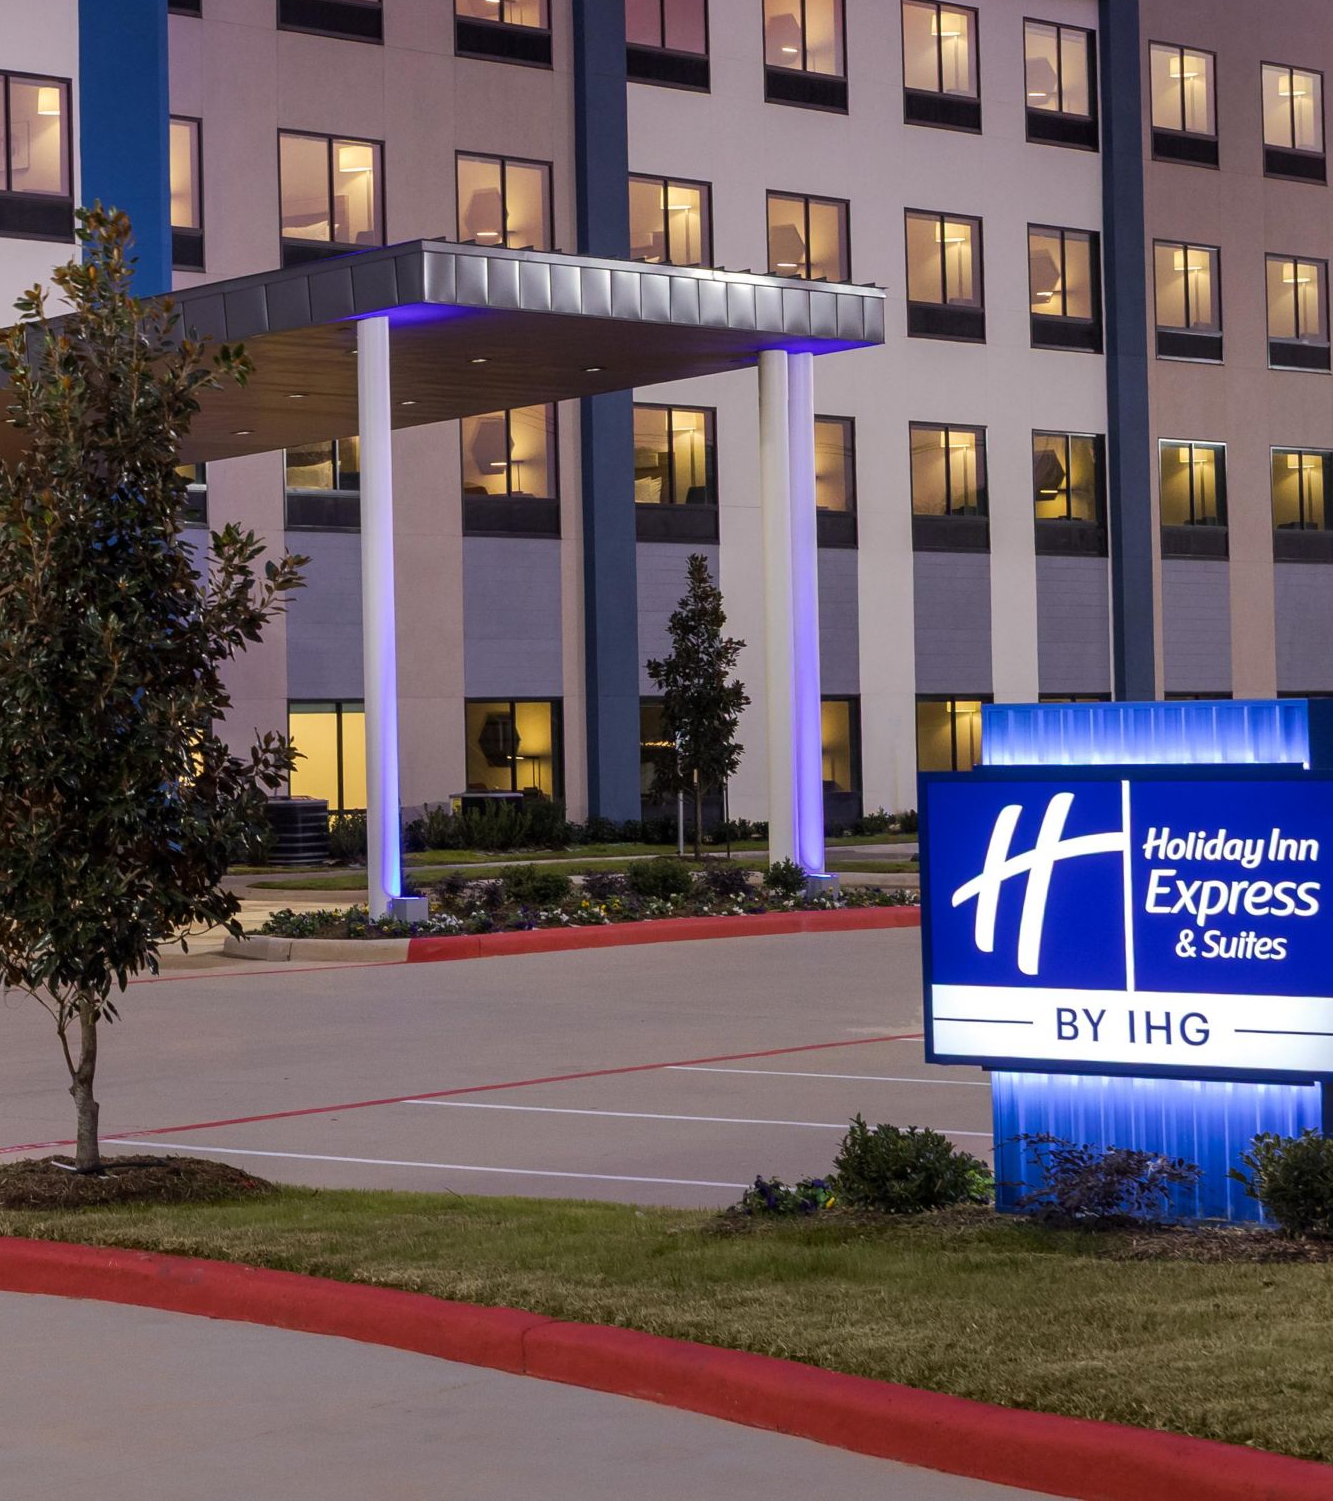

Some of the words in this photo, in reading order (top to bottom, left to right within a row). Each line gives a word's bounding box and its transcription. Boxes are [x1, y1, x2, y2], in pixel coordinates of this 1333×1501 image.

[1142, 827, 1265, 869] Holiday
[1267, 827, 1319, 862] Inn
[1145, 868, 1321, 927] Express
[1175, 928, 1197, 958] &
[1201, 929, 1288, 960] Suites
[1056, 1007, 1106, 1042] BY
[1128, 1010, 1210, 1047] IHG
